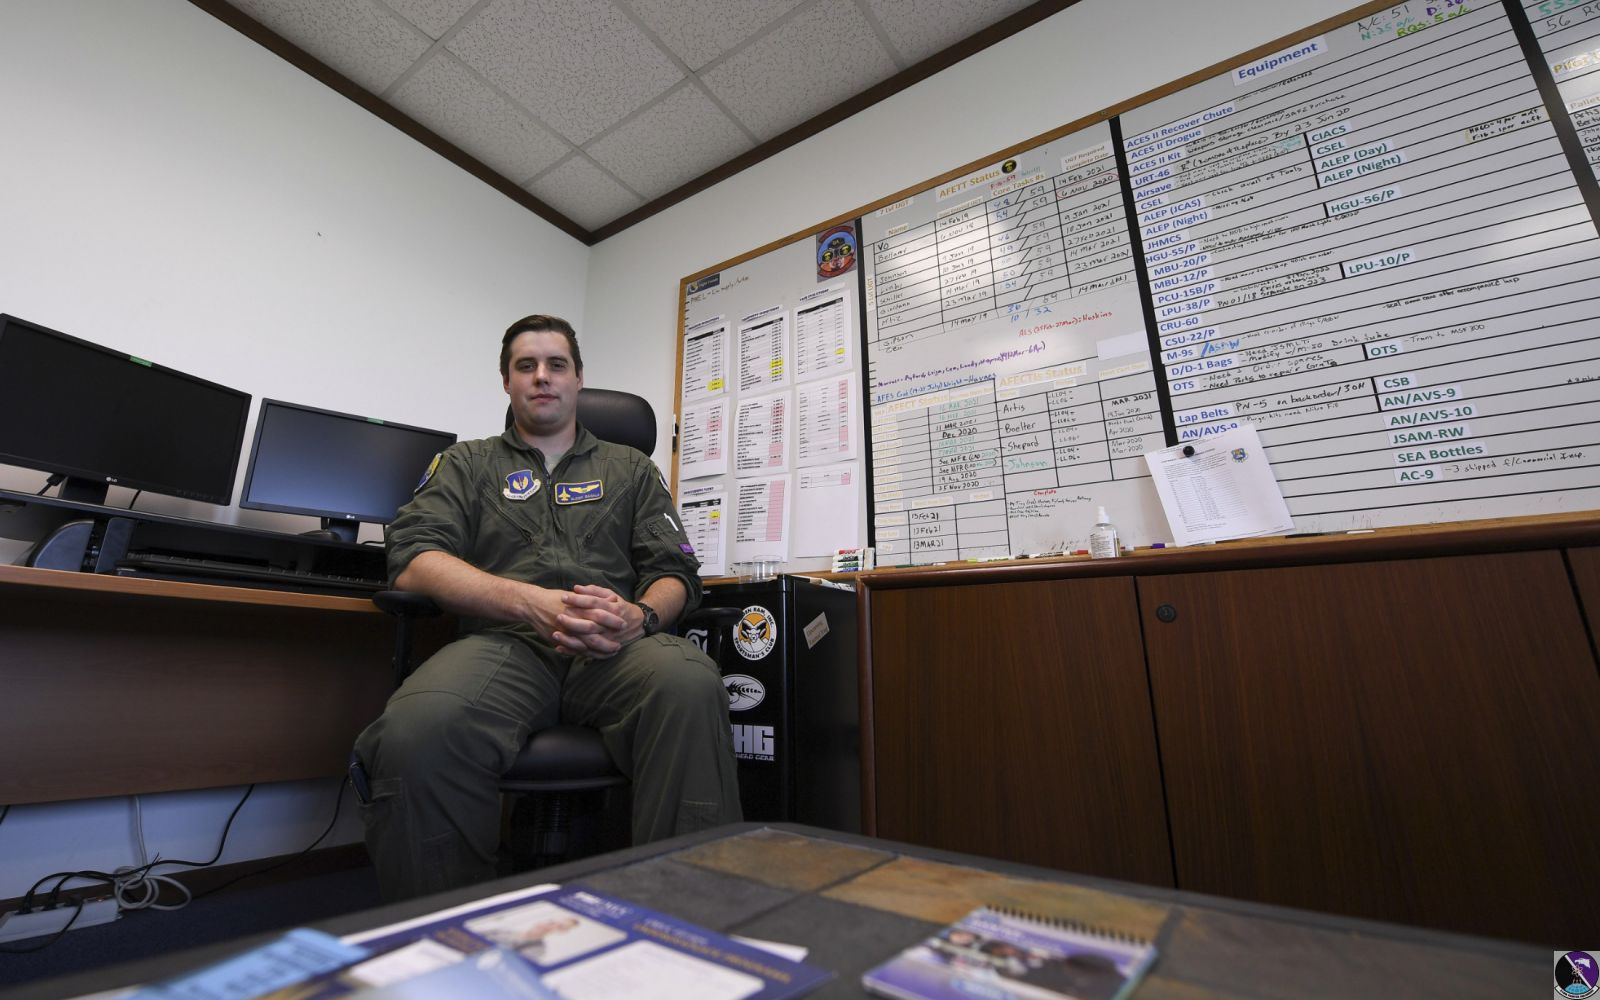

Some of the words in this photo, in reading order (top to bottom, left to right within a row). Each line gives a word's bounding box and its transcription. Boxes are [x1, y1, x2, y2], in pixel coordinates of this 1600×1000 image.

[1547, 15, 1570, 31] 56
[1238, 43, 1318, 79] Equipment
[1127, 136, 1151, 149] ACES
[1161, 117, 1199, 136] Recover
[1203, 106, 1233, 121] Chute
[1312, 125, 1346, 142] CIACS
[1131, 147, 1155, 159] ACES
[1166, 130, 1201, 146] Drogue
[1316, 141, 1345, 155] CSEL
[1133, 160, 1157, 173] ACES
[1168, 151, 1182, 161] Kit
[1321, 154, 1350, 170] ALEP
[1354, 143, 1388, 161] (Day)
[1135, 169, 1170, 186] URT-46
[1324, 168, 1353, 184] ALEP
[1357, 154, 1401, 175] (Night)
[940, 181, 967, 198] AFETT
[970, 170, 1000, 185] Status
[1137, 183, 1172, 198] Airsave
[1141, 198, 1163, 210] CSEL
[1144, 210, 1168, 223] ALEP
[1170, 198, 1202, 215] (JCAS)
[1331, 189, 1395, 213] HGU-56/P
[1146, 222, 1170, 236] ALEP
[1173, 211, 1208, 228] (Night)
[1148, 235, 1182, 250] JHMCS
[1146, 243, 1196, 264] HGU-55/P
[1154, 254, 1207, 276] MBU-20/P
[1349, 252, 1411, 275] LPU-10/P
[1154, 269, 1207, 290] MBU-12/P
[1158, 282, 1215, 304] PCU-15B/P
[1161, 298, 1210, 317] LPU-38/P
[1160, 317, 1198, 332] CRU-60
[1165, 329, 1215, 347] CSU-22/P
[1167, 349, 1193, 361] M-9s
[1371, 344, 1398, 357] OTS
[1171, 363, 1204, 376] D/D-1
[1207, 357, 1233, 370] Bags
[1173, 380, 1194, 391] OTS
[1383, 377, 1410, 389] CSB
[1384, 388, 1456, 406] AN/AVS-9
[1179, 412, 1198, 424] Lap
[1201, 407, 1229, 420] Belts
[1390, 406, 1472, 426] AN/AVS-10
[1182, 422, 1238, 440] AN/AVS-9
[1393, 427, 1464, 445] JSAM-RW
[1398, 450, 1426, 464] SEA
[1430, 445, 1484, 460] Bottles
[1400, 469, 1434, 482] AC-9
[735, 637, 765, 659] SPORTSMAN'S
[765, 638, 775, 653] CLUB
[731, 724, 774, 756] HG
